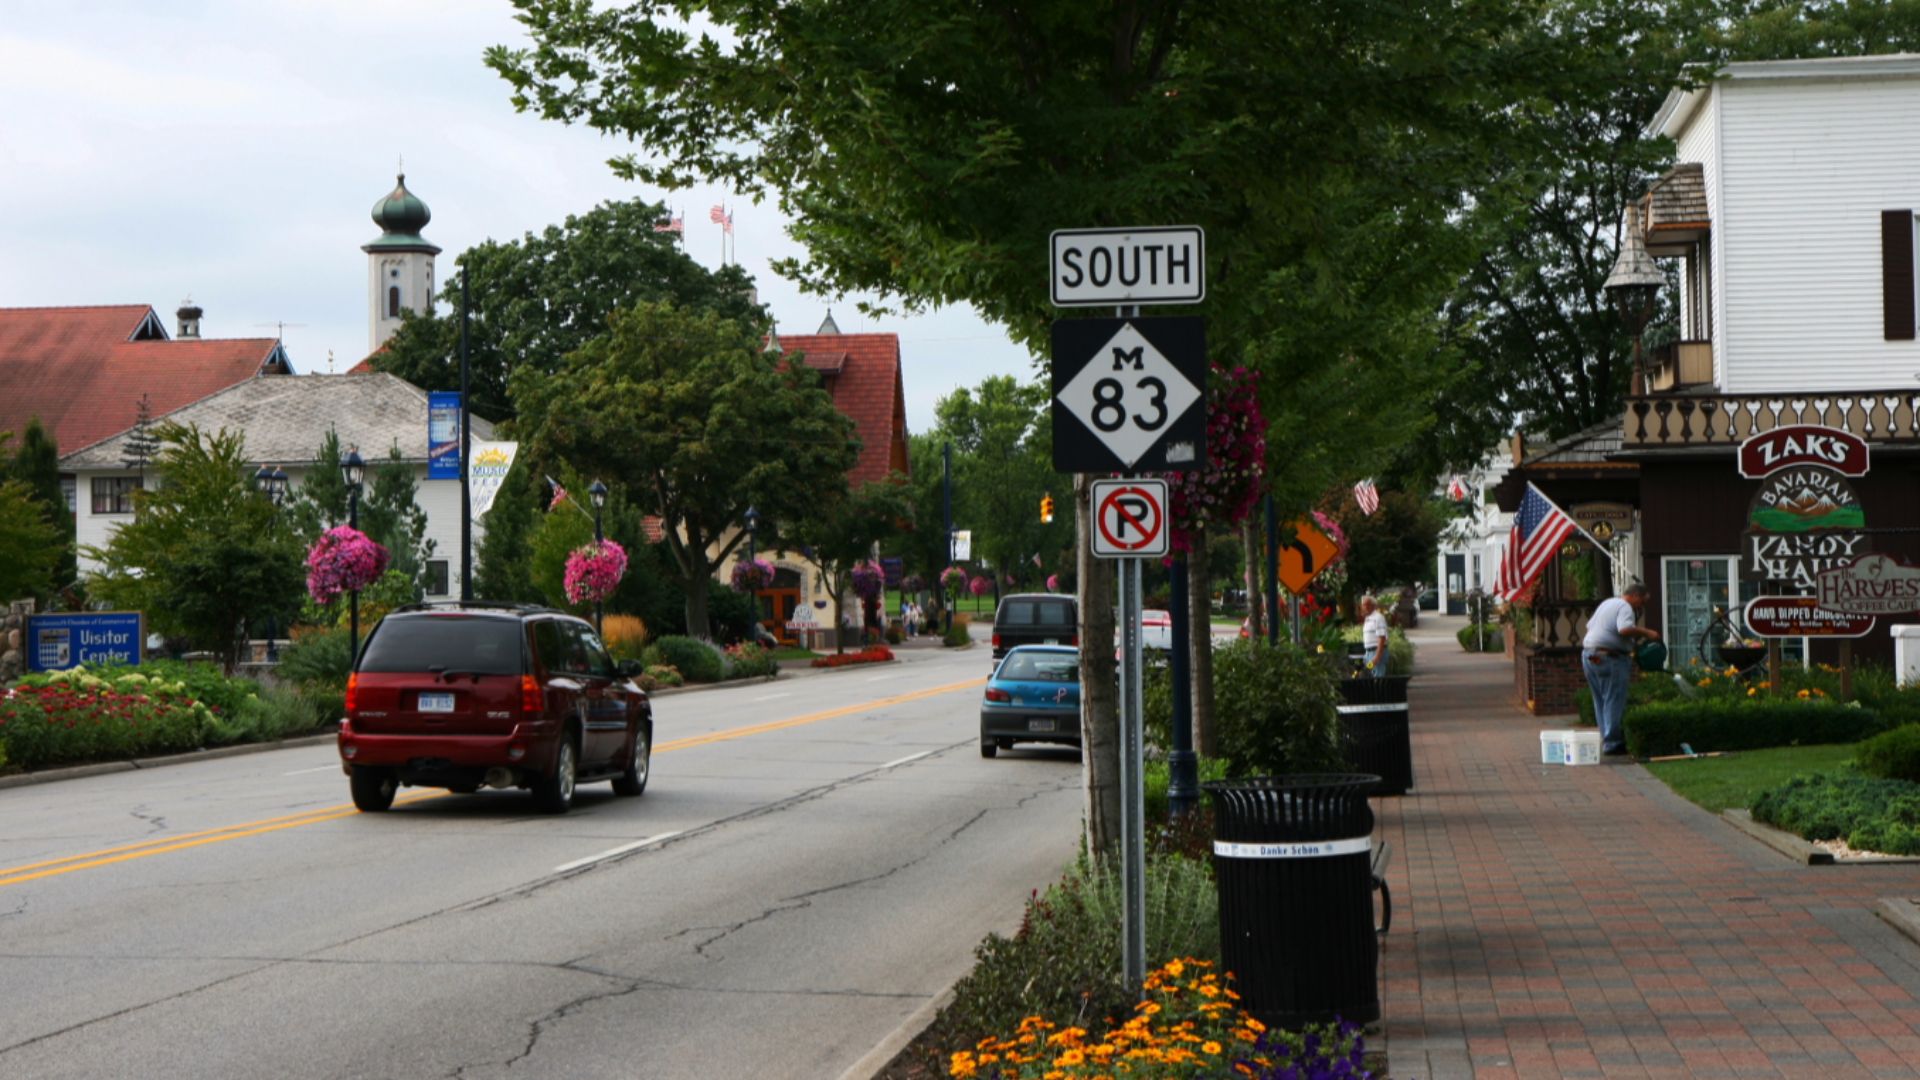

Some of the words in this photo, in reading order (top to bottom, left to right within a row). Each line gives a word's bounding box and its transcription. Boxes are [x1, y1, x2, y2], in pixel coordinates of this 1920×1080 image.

[1061, 244, 1190, 288] SOUTH
[1112, 347, 1144, 370] M
[1090, 376, 1168, 432] 83
[1757, 434, 1849, 466] ZAK'S
[1762, 471, 1853, 505] BAVARIAN
[1751, 535, 1864, 572] KANDY
[1822, 575, 1920, 605] HARVES
[1753, 608, 1776, 621] HAND
[1779, 607, 1811, 621] DIPPED
[1841, 600, 1885, 612] COFFEE
[80, 630, 129, 645] Visitor
[79, 648, 130, 664] Center
[1260, 846, 1288, 856] Danke
